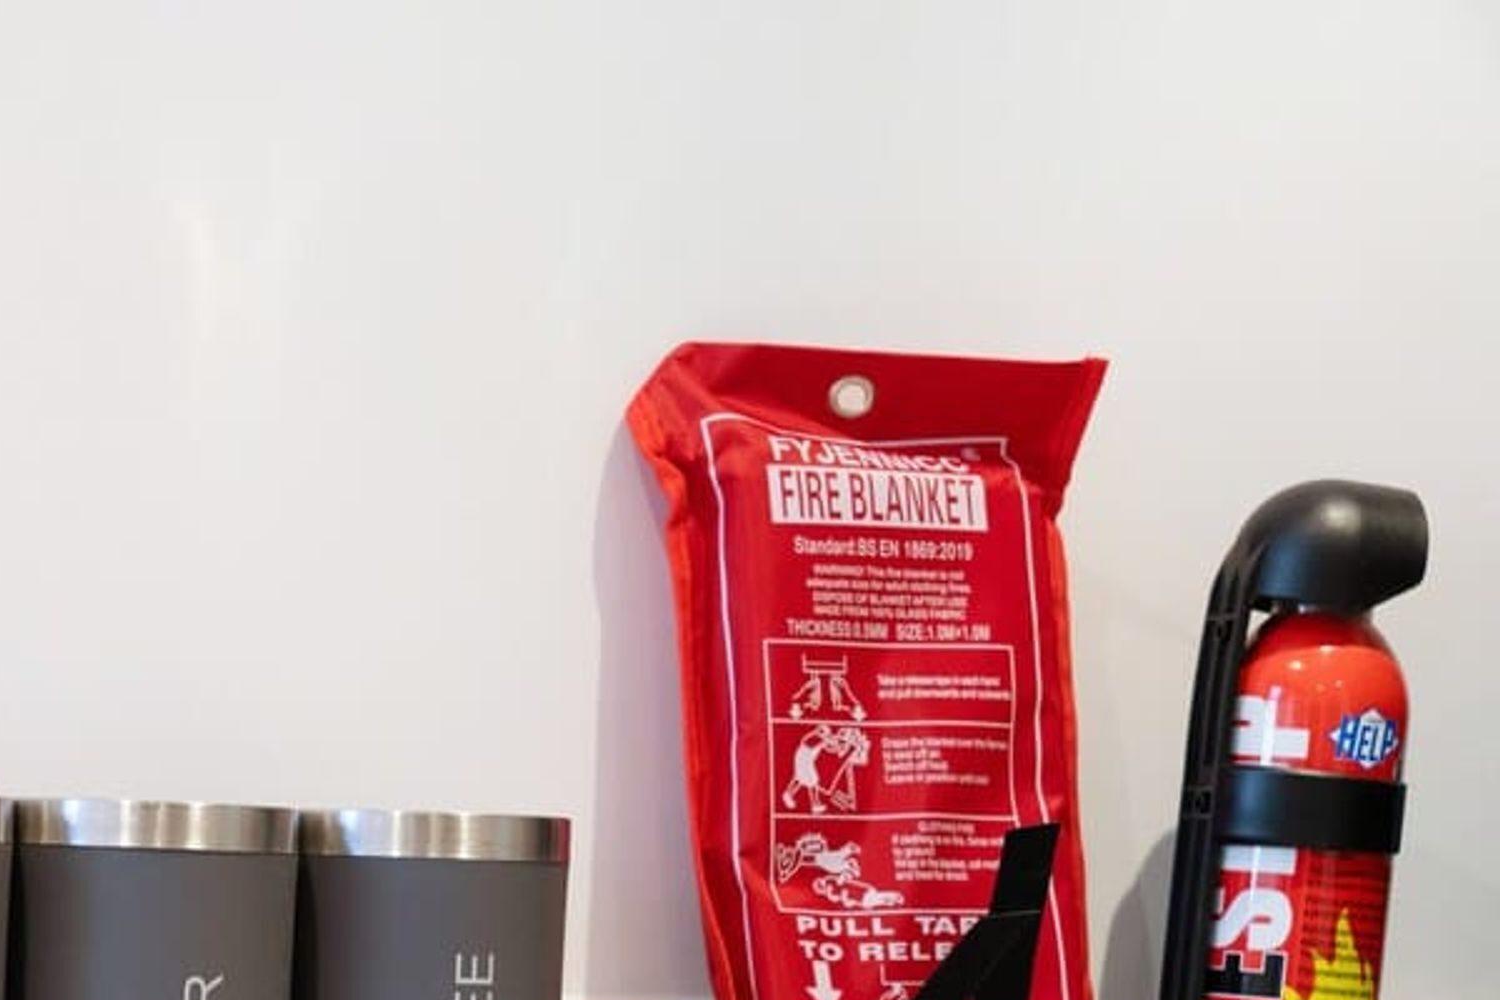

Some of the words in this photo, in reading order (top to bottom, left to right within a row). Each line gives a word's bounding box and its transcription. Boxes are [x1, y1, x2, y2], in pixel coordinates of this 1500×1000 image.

[779, 470, 842, 519] FIRE
[851, 473, 974, 526] BLANKET
[879, 539, 899, 558] EN
[1336, 714, 1397, 761] HELP
[796, 915, 895, 937] PULL
[798, 940, 844, 961] TO
